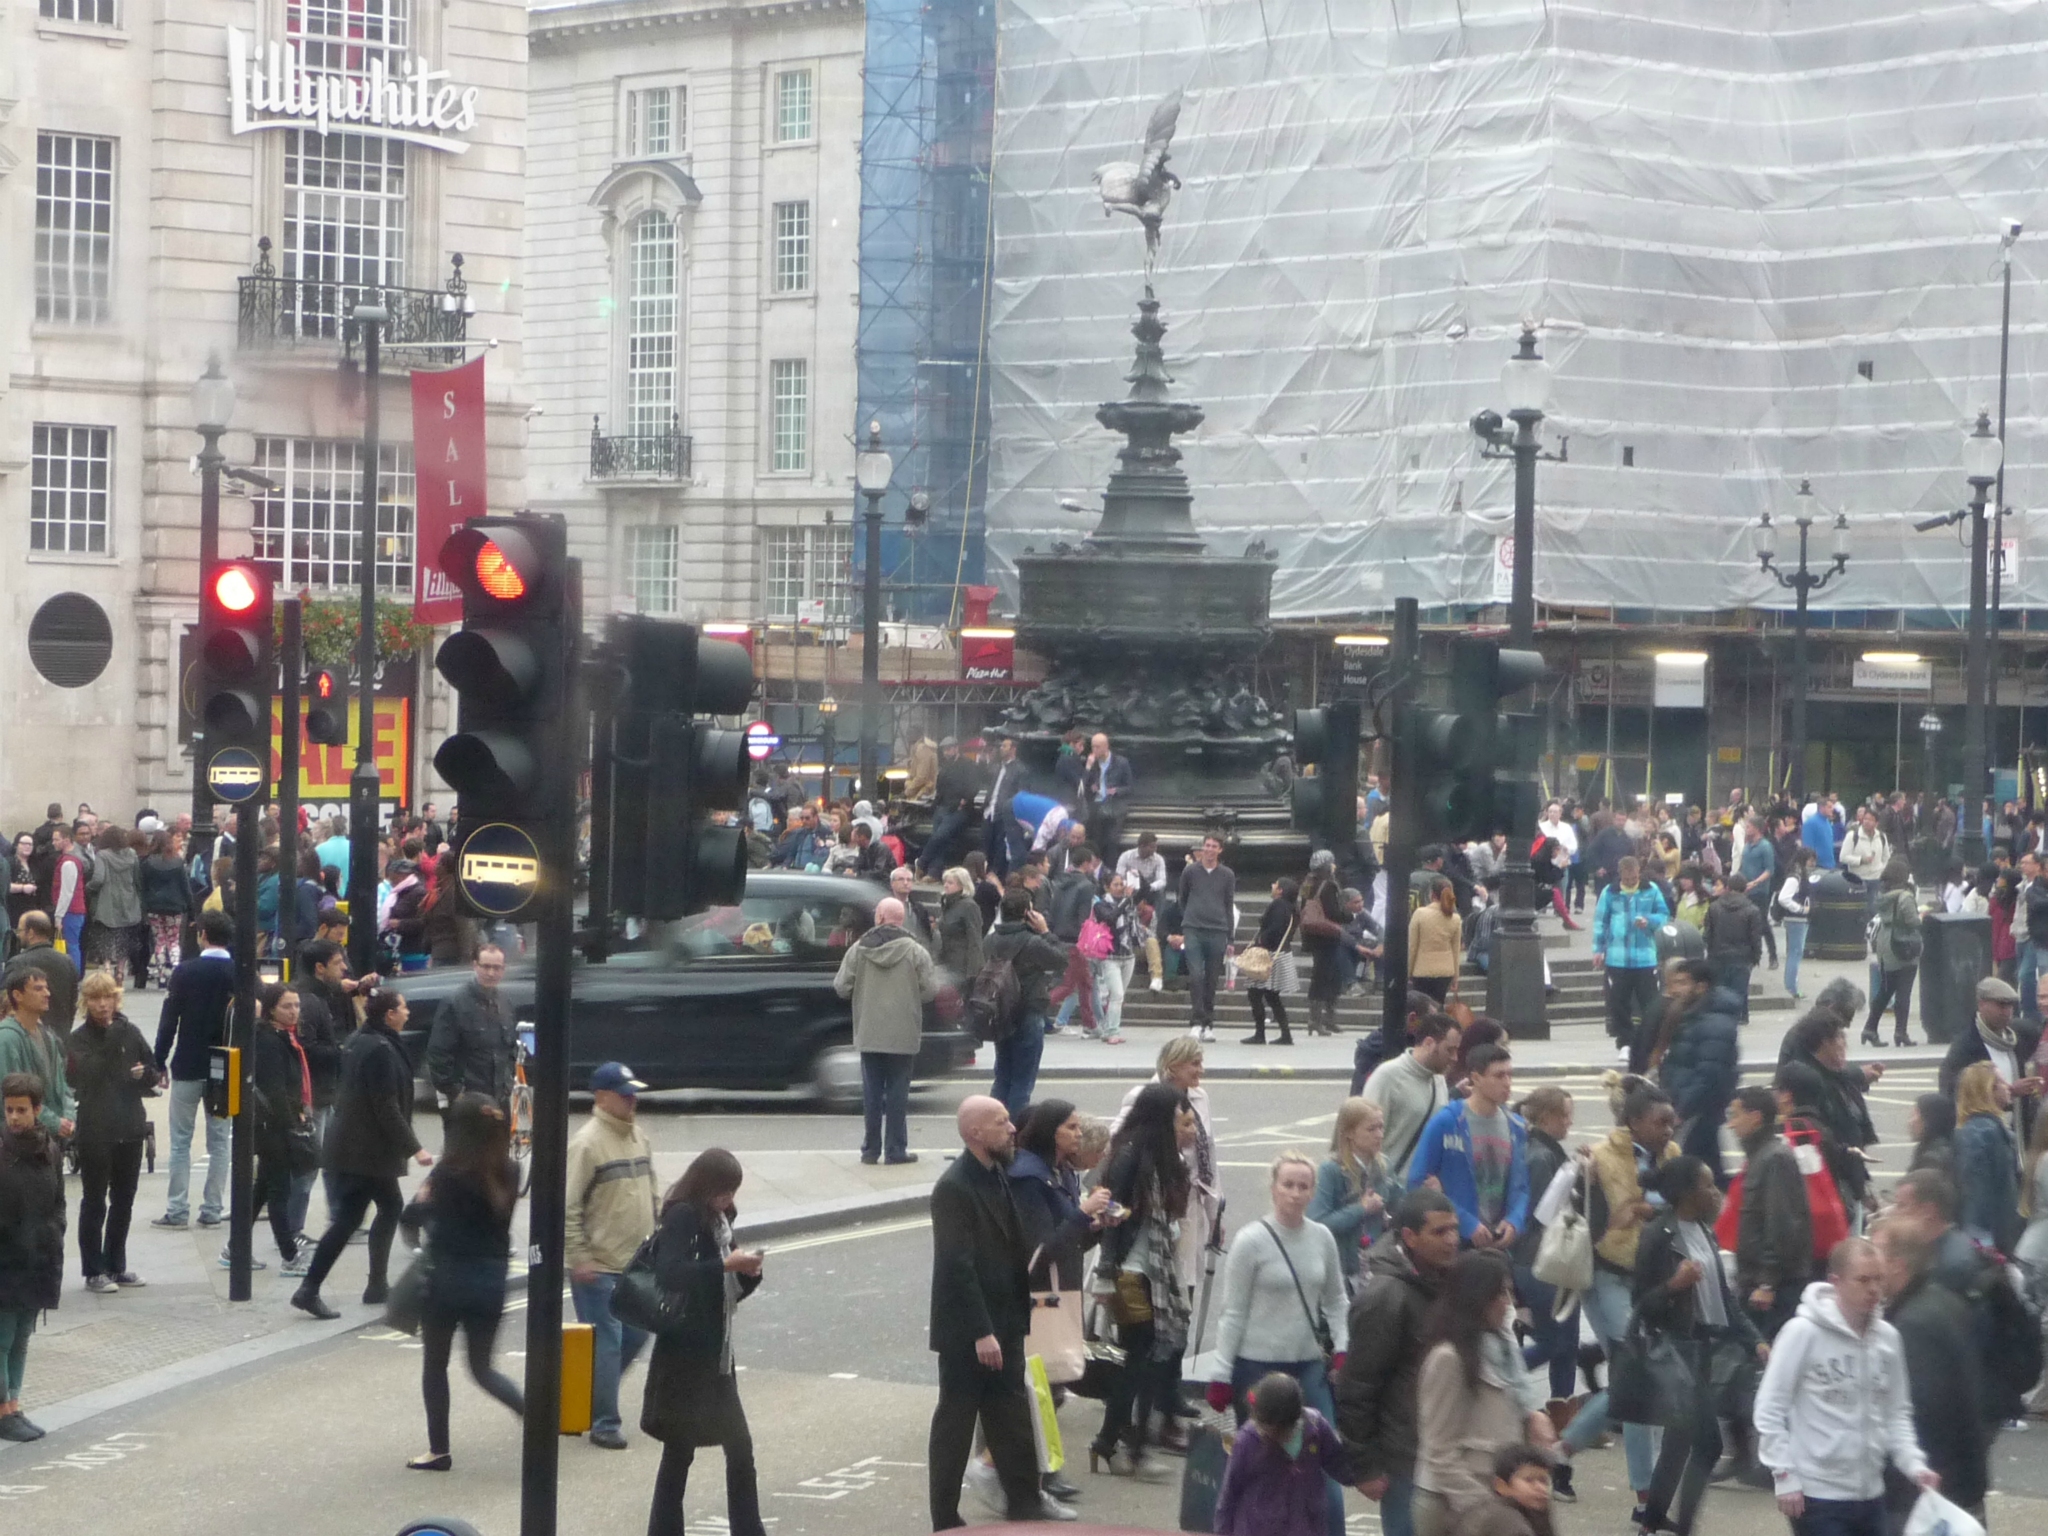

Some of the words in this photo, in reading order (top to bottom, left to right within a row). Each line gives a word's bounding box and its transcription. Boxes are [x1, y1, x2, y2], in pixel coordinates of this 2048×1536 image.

[228, 24, 478, 140] Lillywhites
[1344, 660, 1362, 670] Bank
[1344, 673, 1367, 685] House
[271, 713, 396, 786] ALE
[31, 1432, 164, 1471] LOOK
[772, 1456, 927, 1500] LEFT
